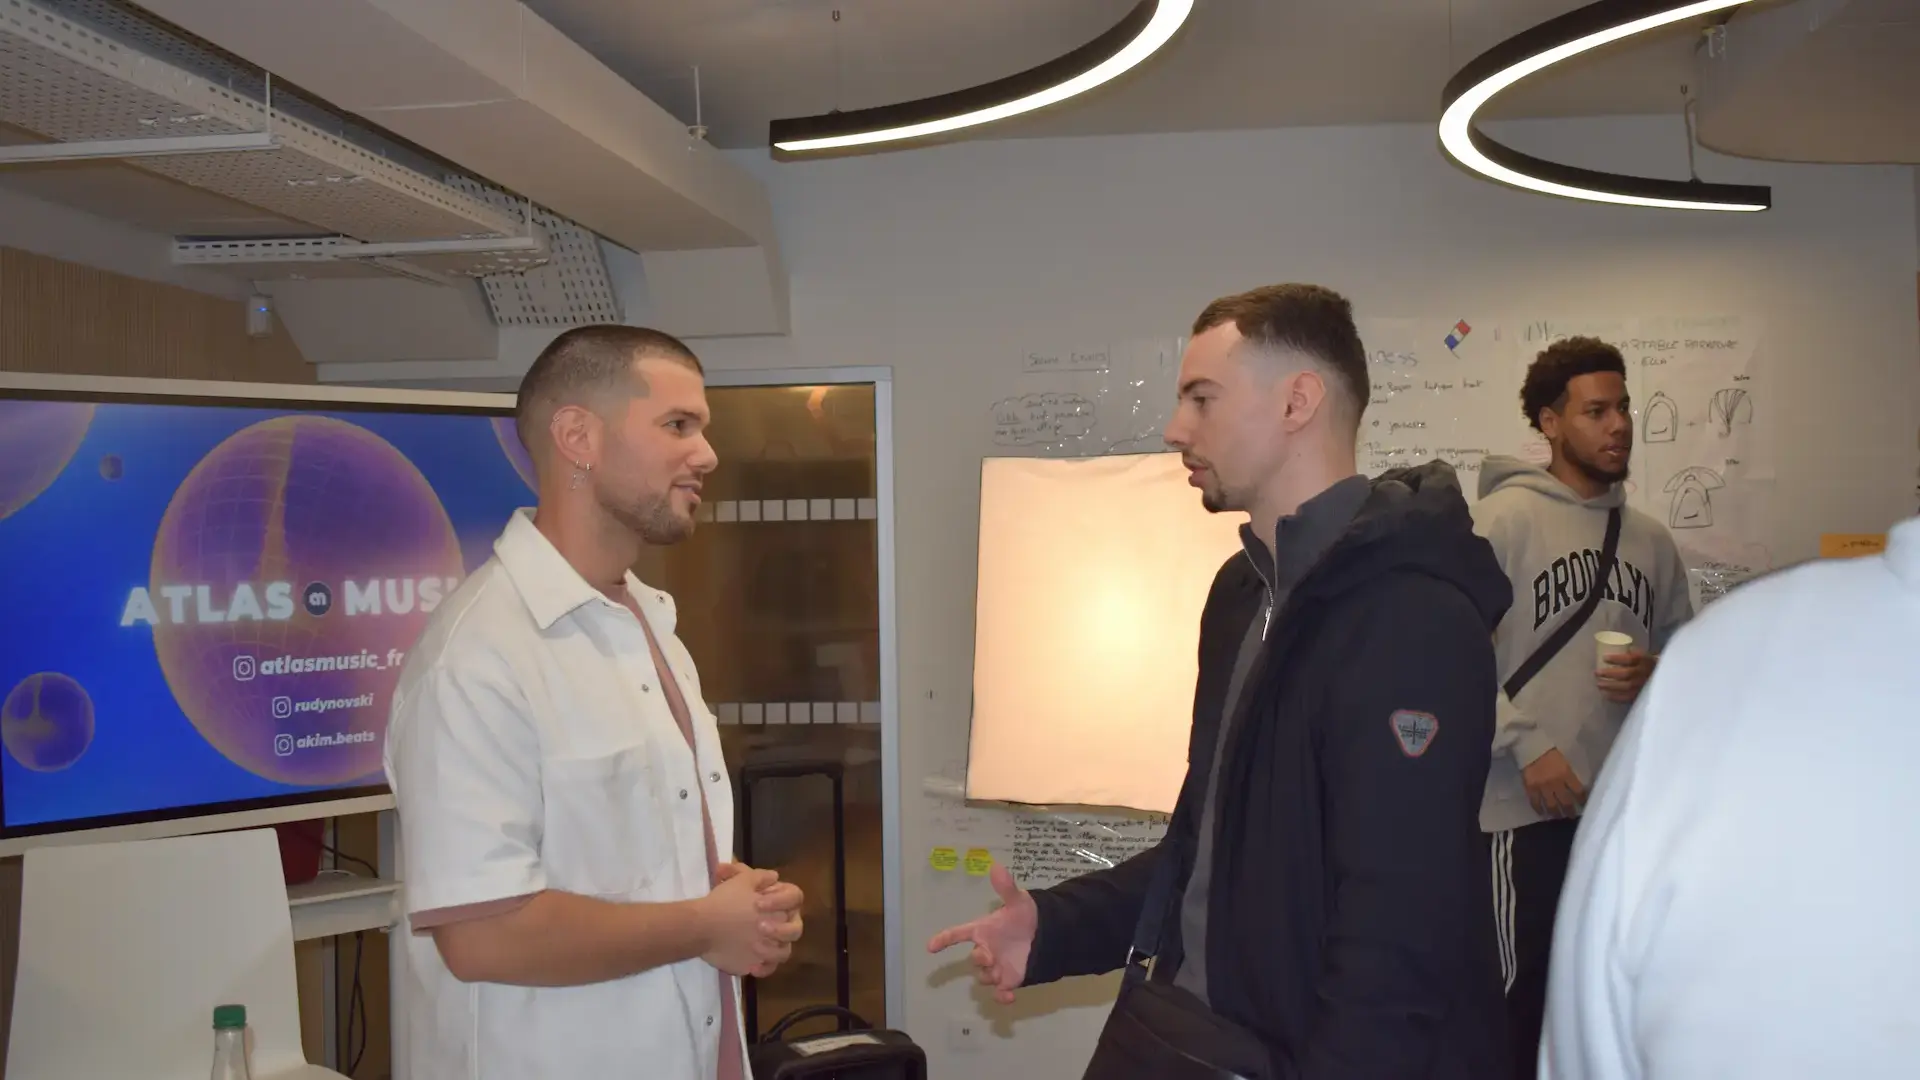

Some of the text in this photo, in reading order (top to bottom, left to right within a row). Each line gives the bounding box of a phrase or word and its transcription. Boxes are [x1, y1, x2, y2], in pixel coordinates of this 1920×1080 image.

[119, 580, 295, 627] ATLAS
[344, 576, 457, 617] MUS
[260, 648, 404, 677] atlasmusic_fr
[294, 693, 374, 714] rudynovski
[296, 730, 376, 750] akim.beats
